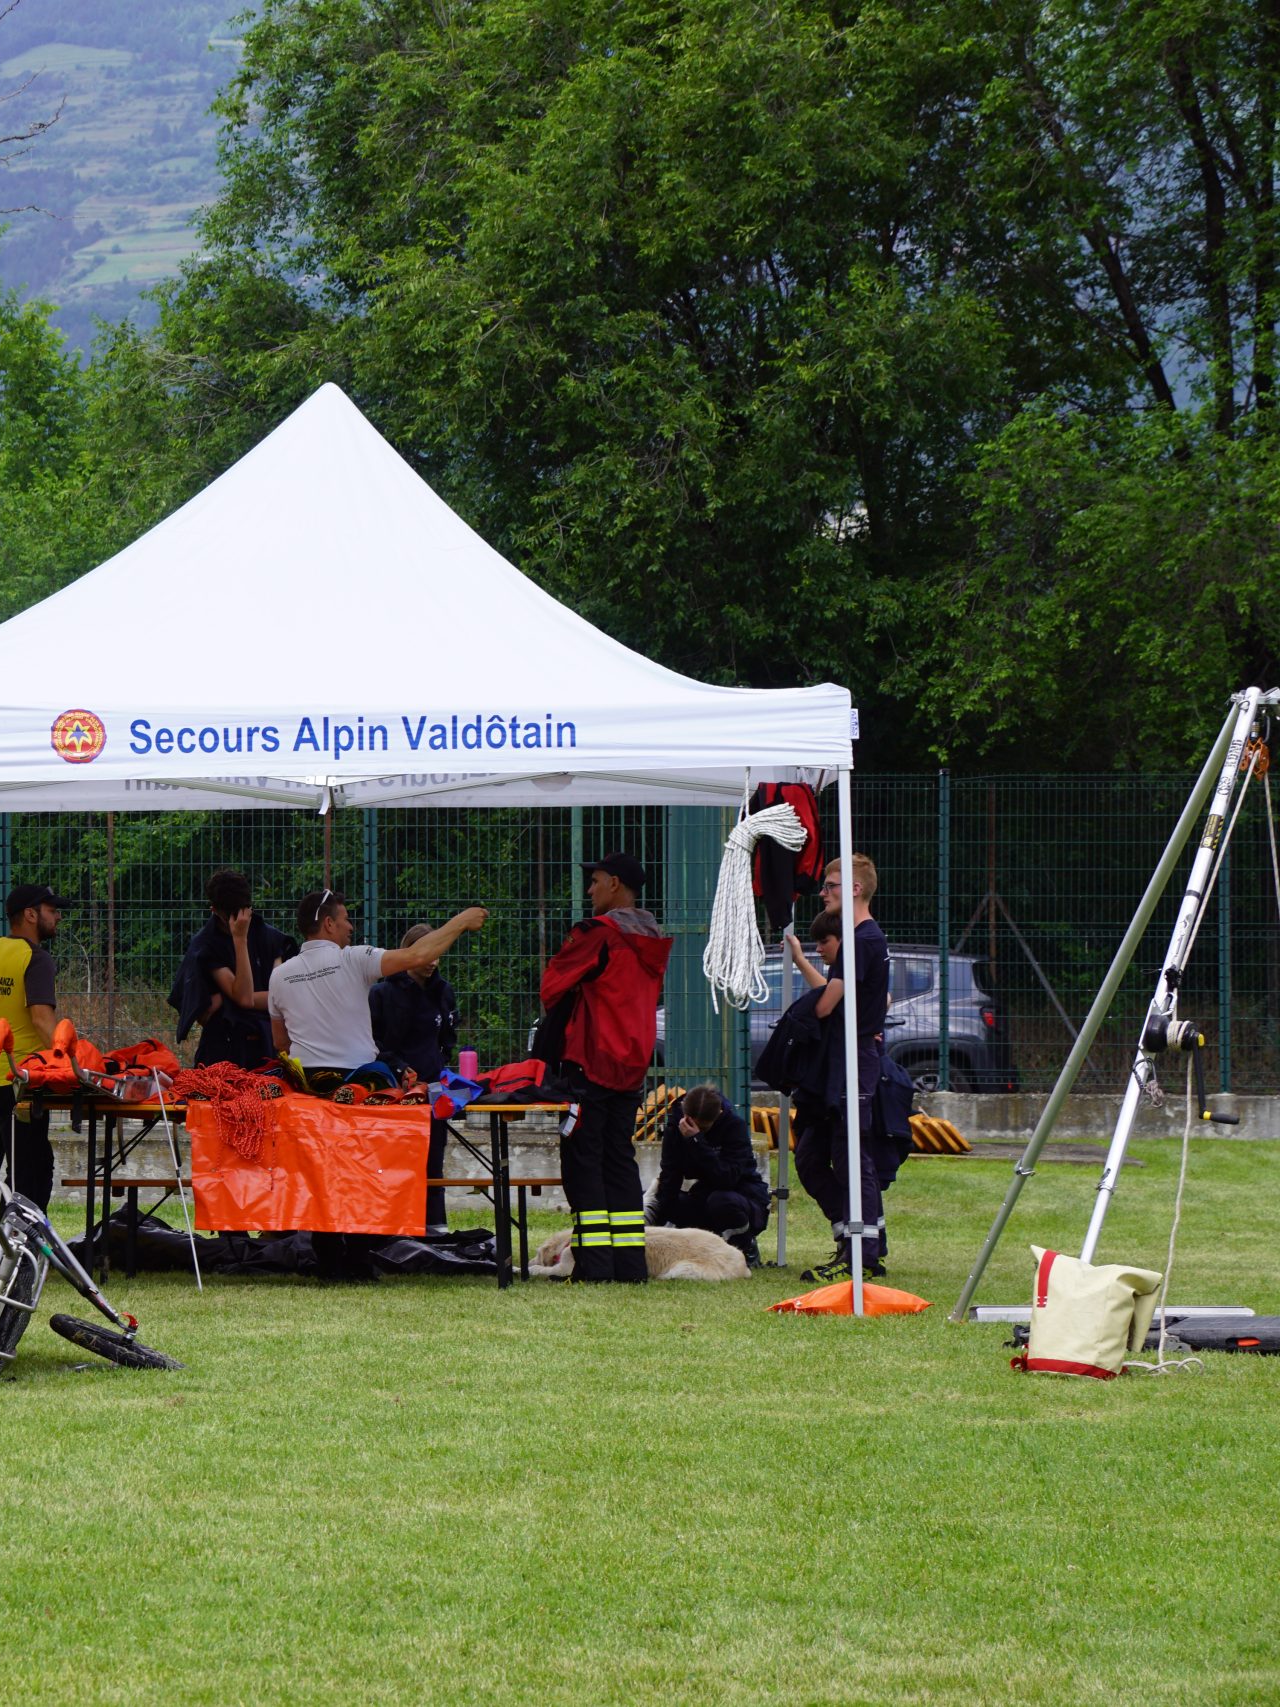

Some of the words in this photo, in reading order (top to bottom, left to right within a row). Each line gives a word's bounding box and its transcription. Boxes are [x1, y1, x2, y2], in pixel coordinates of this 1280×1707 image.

[129, 719, 280, 755] Secours
[293, 716, 388, 760] Alpin
[401, 713, 577, 750] Valdôtain
